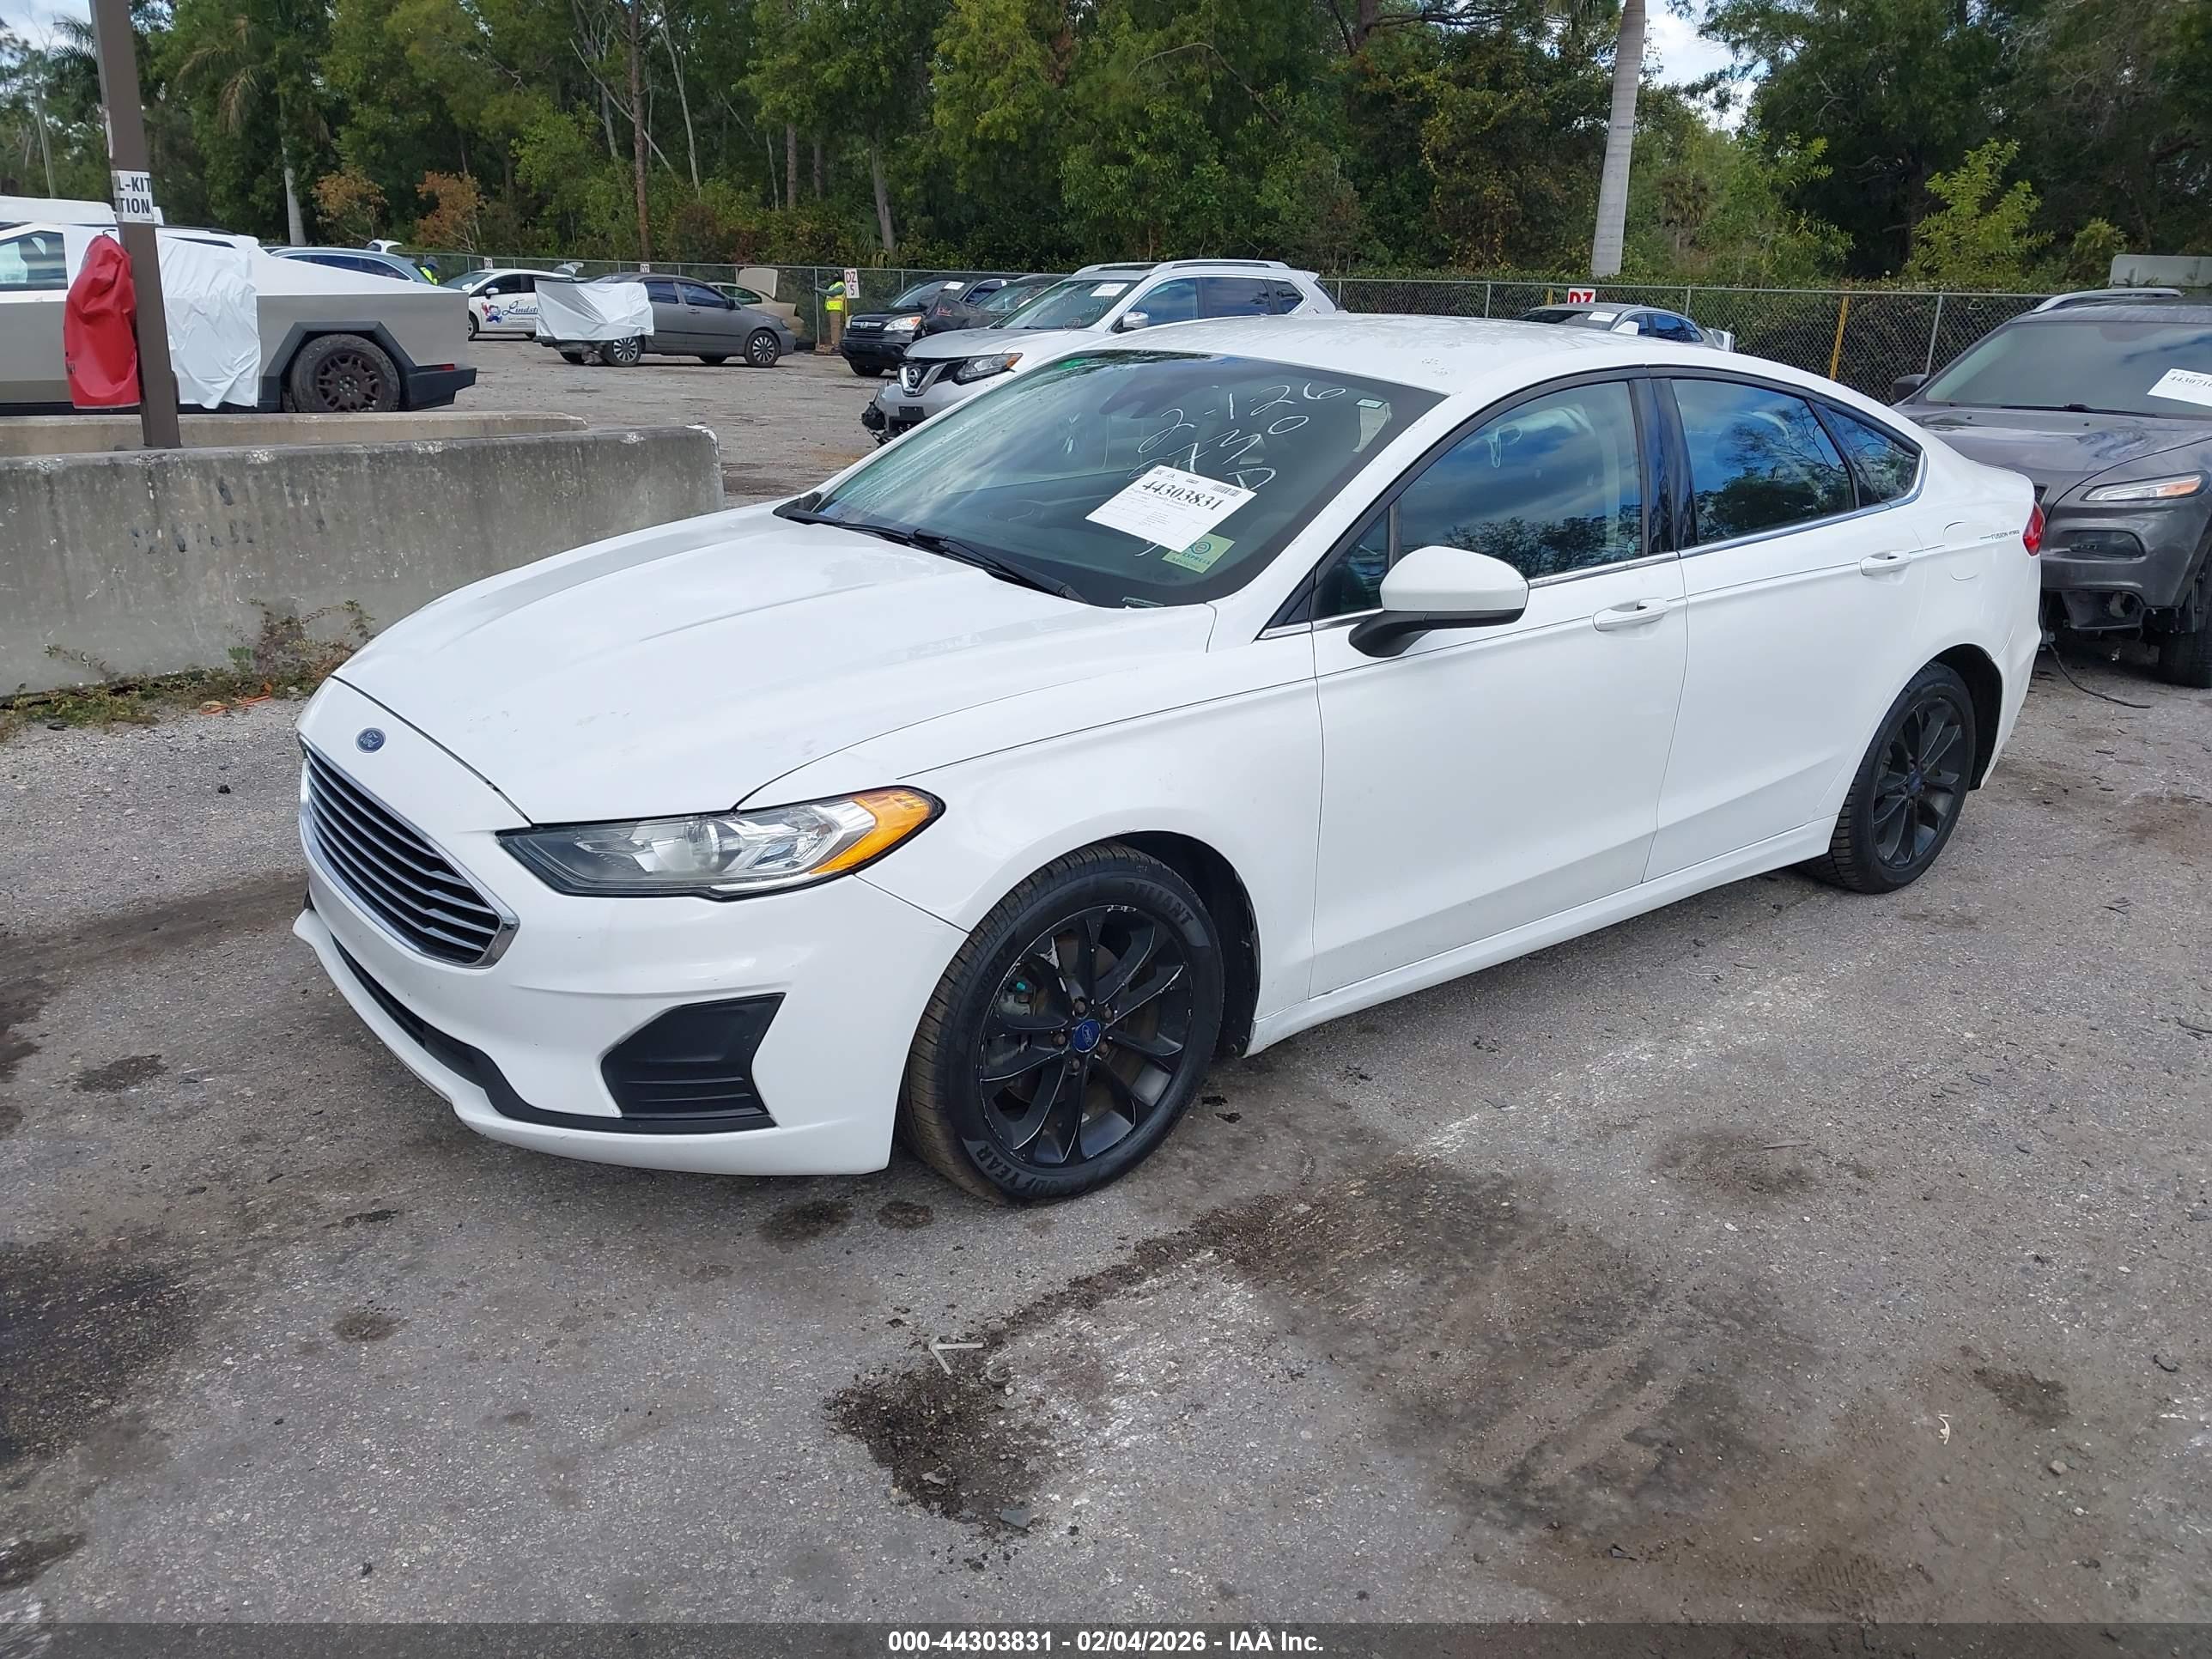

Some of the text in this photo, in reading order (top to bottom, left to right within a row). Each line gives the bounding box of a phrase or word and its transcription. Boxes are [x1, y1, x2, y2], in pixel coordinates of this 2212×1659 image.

[845, 270, 857, 283] DZ
[849, 284, 855, 296] 5
[1141, 479, 1225, 511] 44303831
